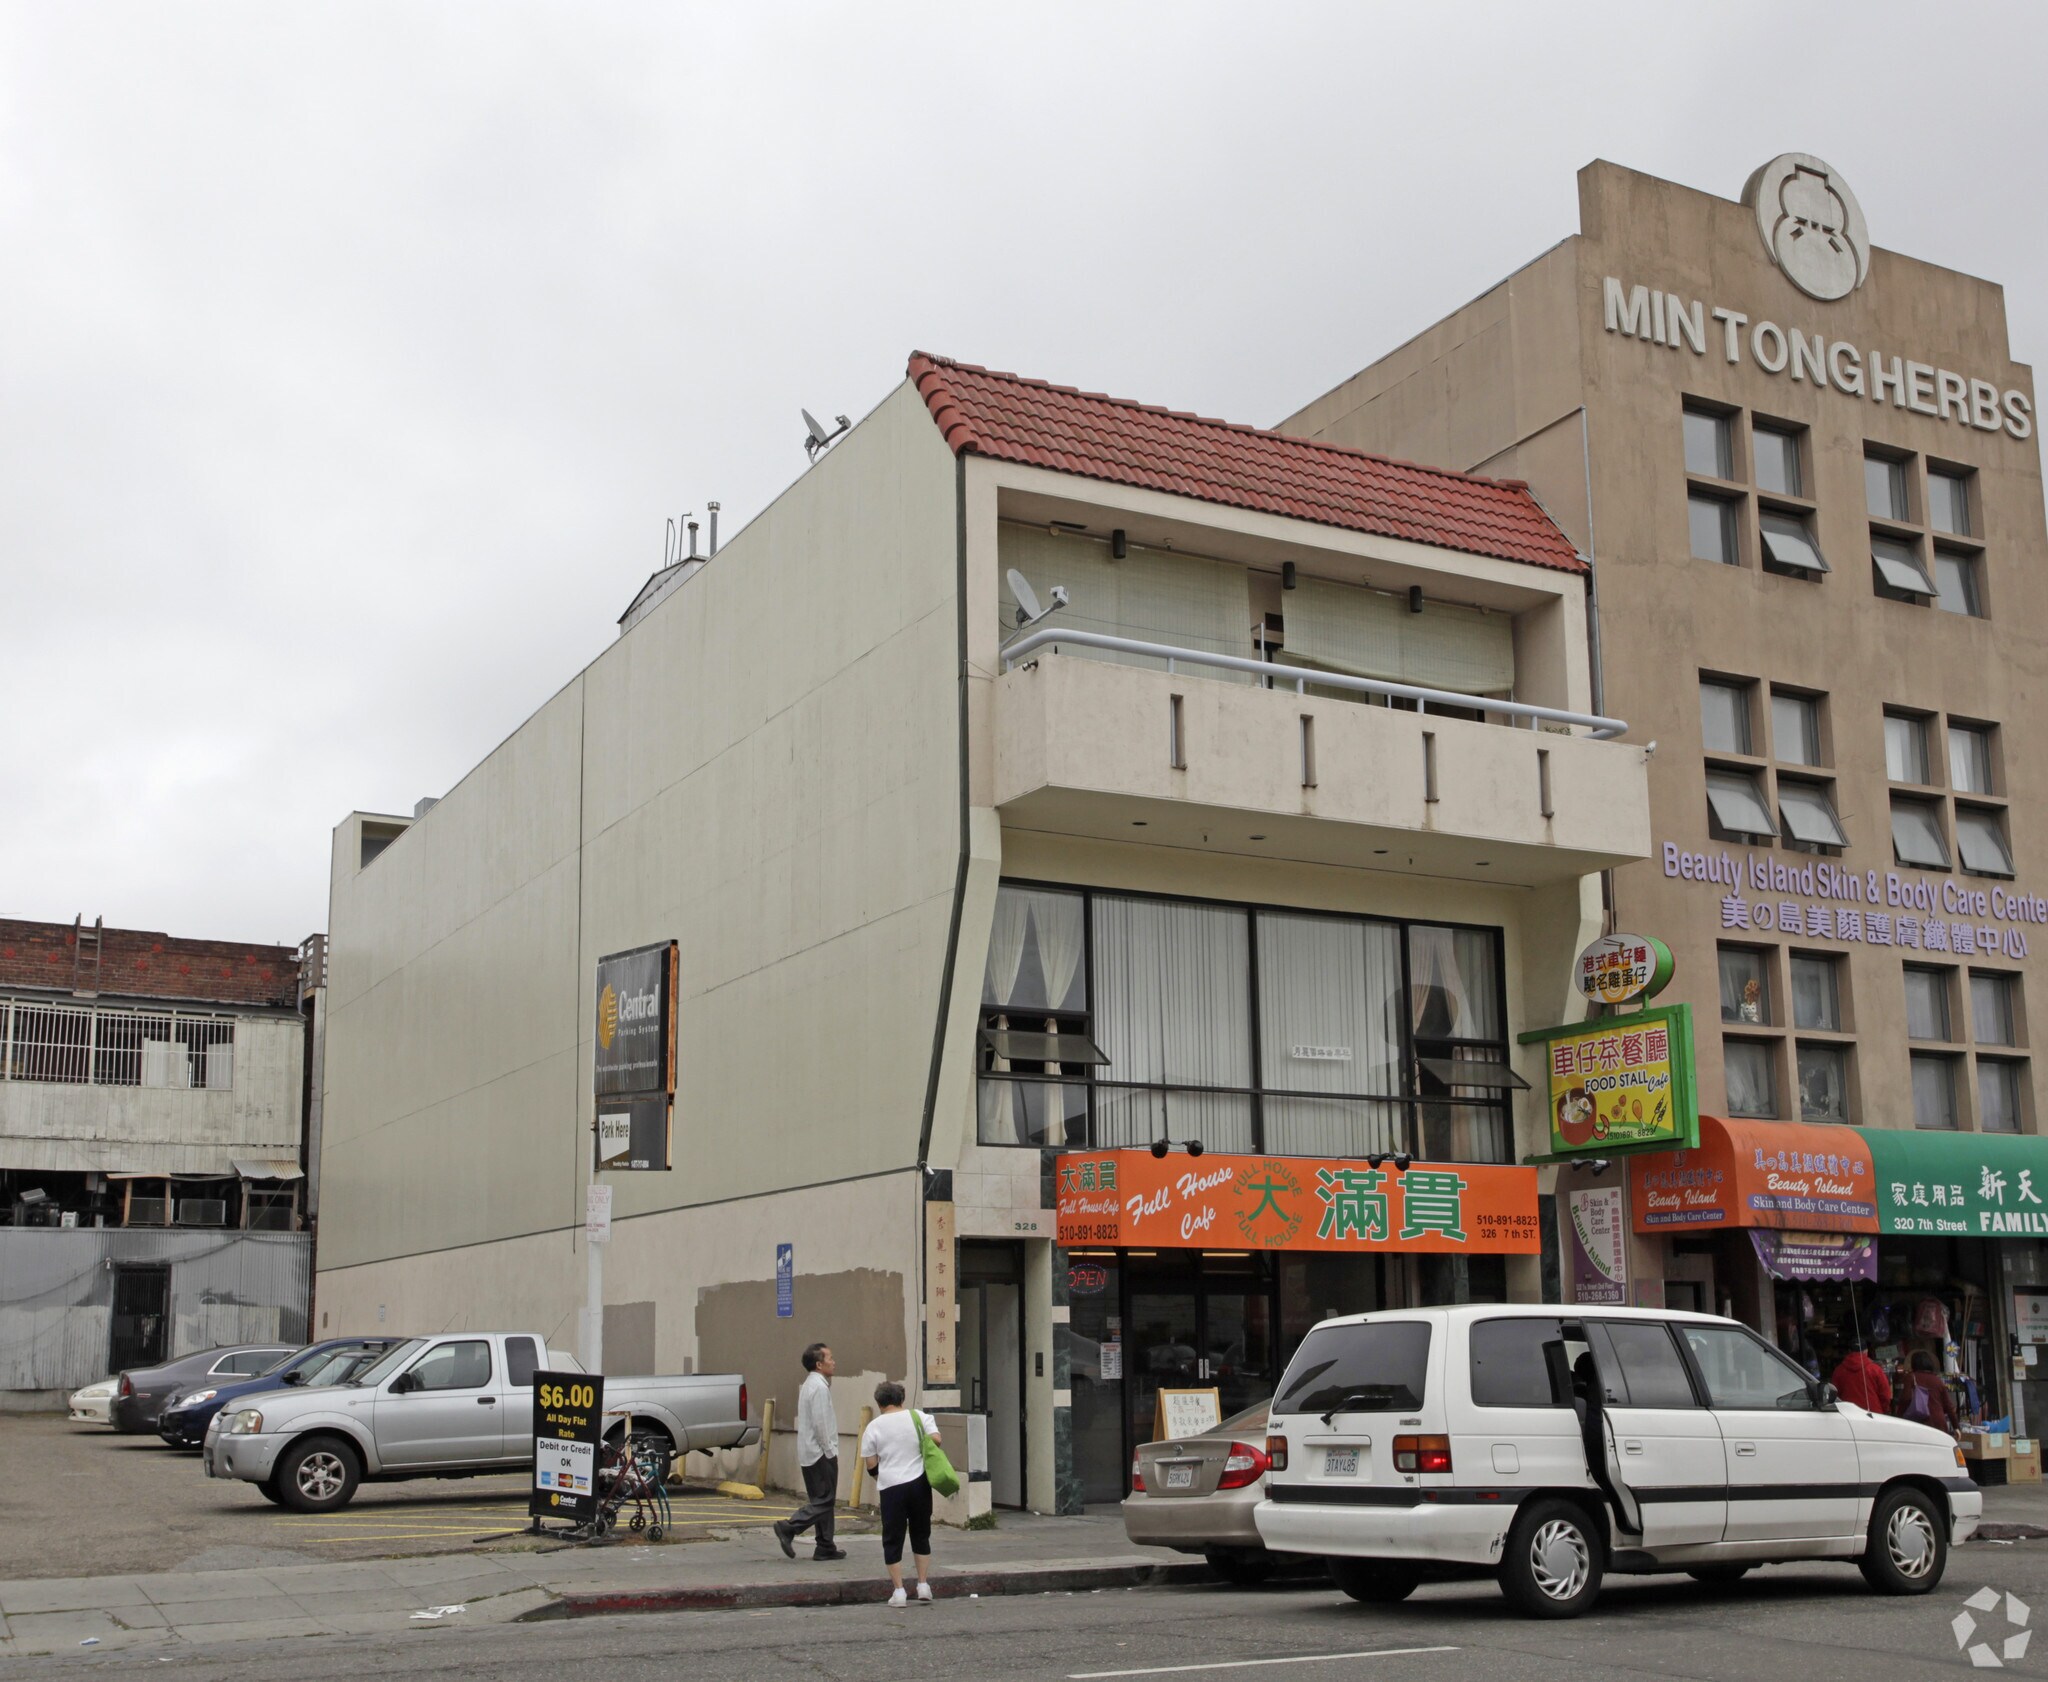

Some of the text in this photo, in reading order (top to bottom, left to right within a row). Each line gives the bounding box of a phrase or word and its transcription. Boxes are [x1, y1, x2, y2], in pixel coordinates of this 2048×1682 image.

[1603, 276, 2032, 440] MIN TONG HERBS
[1662, 841, 2048, 924] Beauty Island Skin & Body Care Cente
[619, 983, 659, 1022] Central
[618, 1025, 659, 1037] Parking System
[1553, 1028, 1668, 1077] 車仔茶餐廳
[1585, 1072, 1669, 1094] FOOD STALL Cafe
[601, 1120, 629, 1138] Park Here
[1060, 1160, 1117, 1195] 大滿貫
[1233, 1159, 1303, 1198] FULL HOUSE
[1767, 1173, 1854, 1196] Beauty Island
[1126, 1167, 1233, 1226] Full House
[1648, 1189, 1717, 1210] Beauty Island
[1891, 1182, 1965, 1207] 家庭用品
[1059, 1197, 1119, 1217] Full House Cafe
[1590, 1208, 1605, 1218] Body
[1753, 1196, 1869, 1215] Skin and Body Care Center
[1180, 1205, 1216, 1240] Cafe
[1476, 1215, 1538, 1226] 510-891-8823
[1591, 1218, 1604, 1226] Care
[1646, 1215, 1659, 1223] Skin
[1672, 1213, 1686, 1223] Body
[1687, 1212, 1701, 1220] Care
[1702, 1211, 1722, 1220] Center
[1894, 1217, 1967, 1231] 320 7th Street
[1015, 1222, 1038, 1231] 328
[1059, 1224, 1119, 1241] 510-891-8823
[1234, 1210, 1303, 1248] FULL HOUSE
[1481, 1229, 1497, 1238] 326
[1522, 1229, 1536, 1239] ST.
[1591, 1227, 1610, 1235] Center
[1572, 1205, 1611, 1276] Beauty Island
[1067, 1270, 1108, 1287] OPEN
[540, 1383, 594, 1409] $6.00
[546, 1413, 587, 1426] All Day Flat
[558, 1429, 575, 1439] Rate
[540, 1440, 559, 1450] Debit
[570, 1444, 591, 1455] Credit
[560, 1459, 571, 1467] OK
[1326, 1458, 1356, 1472] 3TAY485
[560, 1495, 577, 1505] Central
